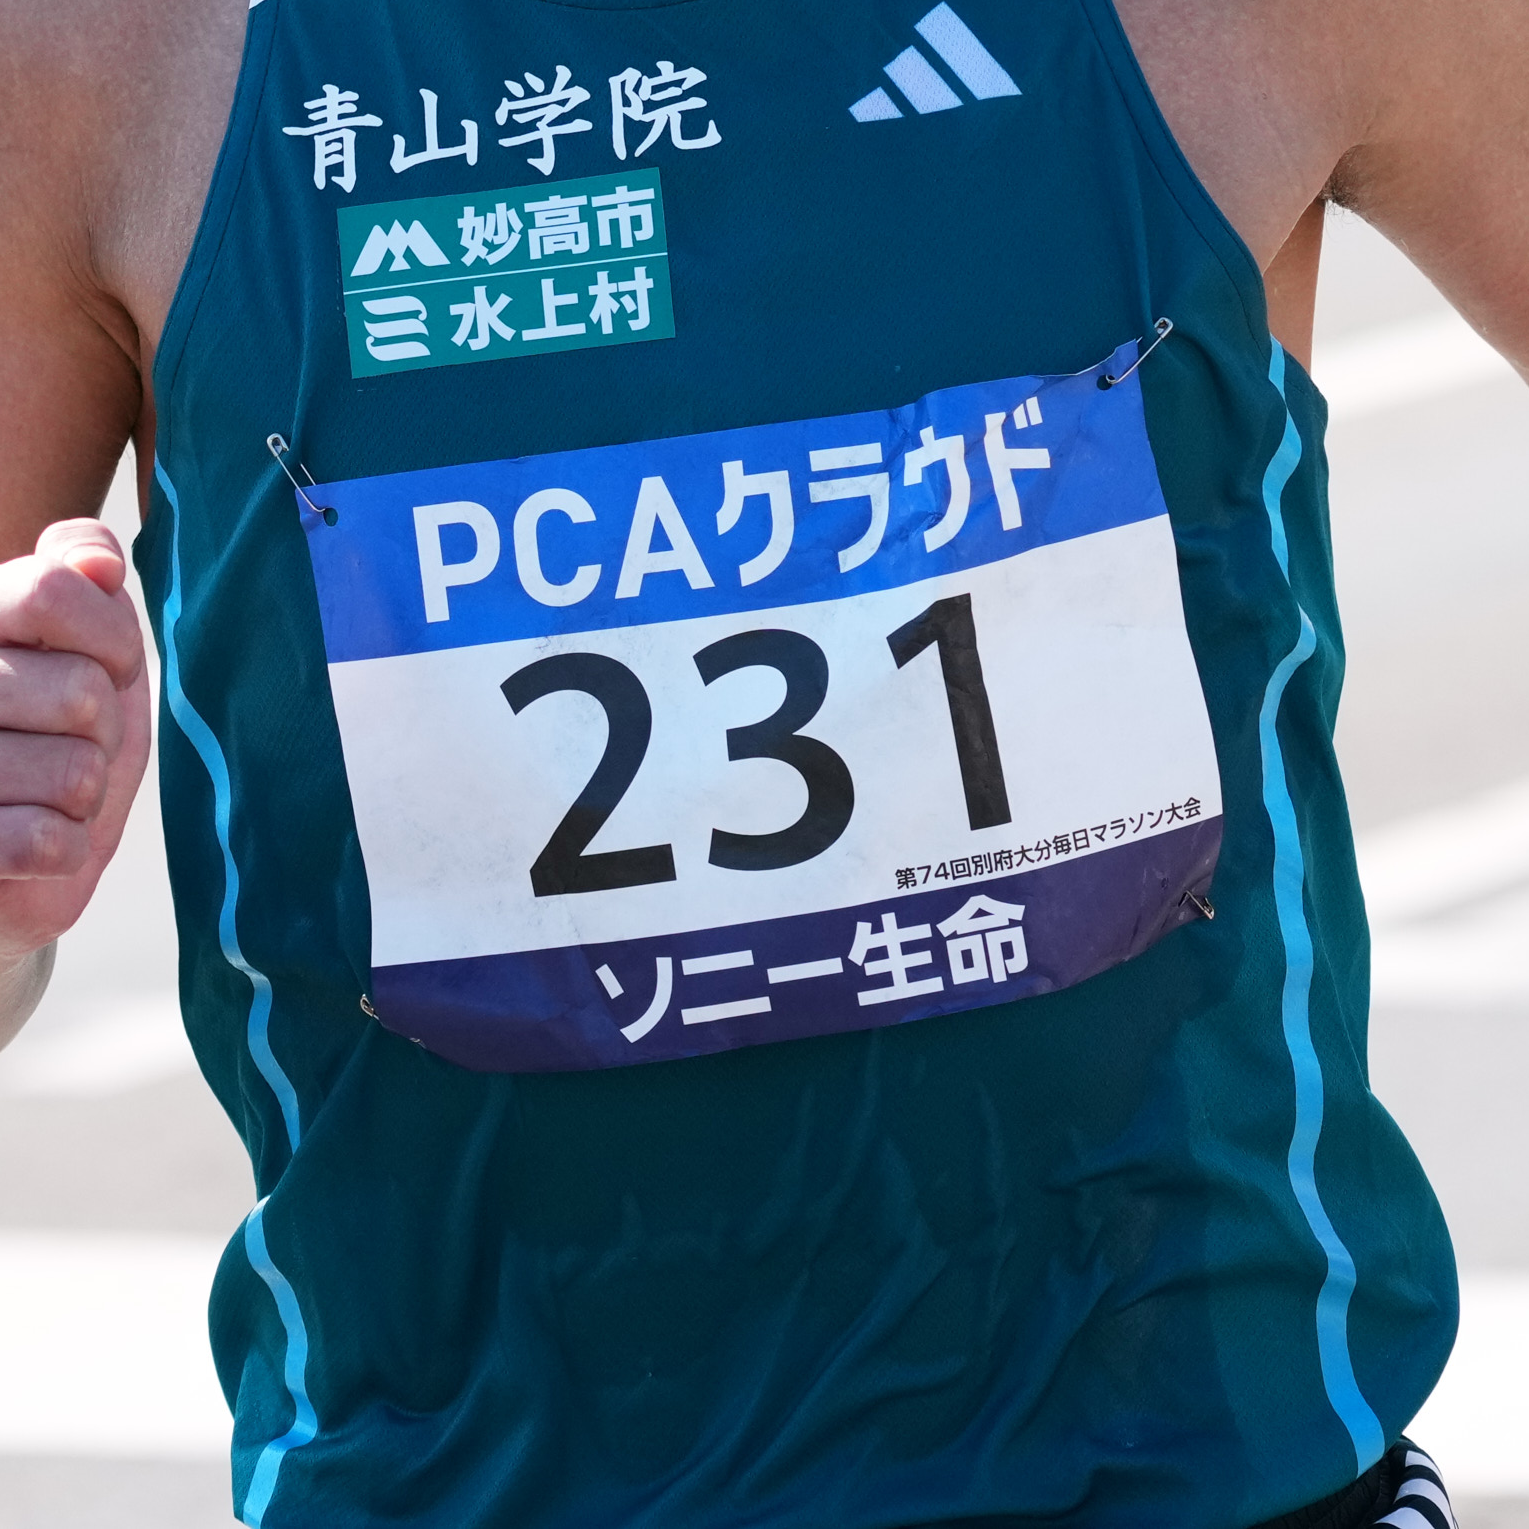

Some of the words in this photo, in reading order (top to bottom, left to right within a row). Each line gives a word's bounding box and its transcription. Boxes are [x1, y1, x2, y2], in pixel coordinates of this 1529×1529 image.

[282, 61, 722, 194] 青山学院
[456, 185, 657, 267] 妙高市
[449, 267, 654, 351] 水上村
[412, 397, 1051, 624] PCAクラウド
[498, 592, 1012, 899] 231
[895, 797, 1202, 890] 第74回別府大分毎日マラソン大会
[594, 894, 1030, 1044] ソニー生命
